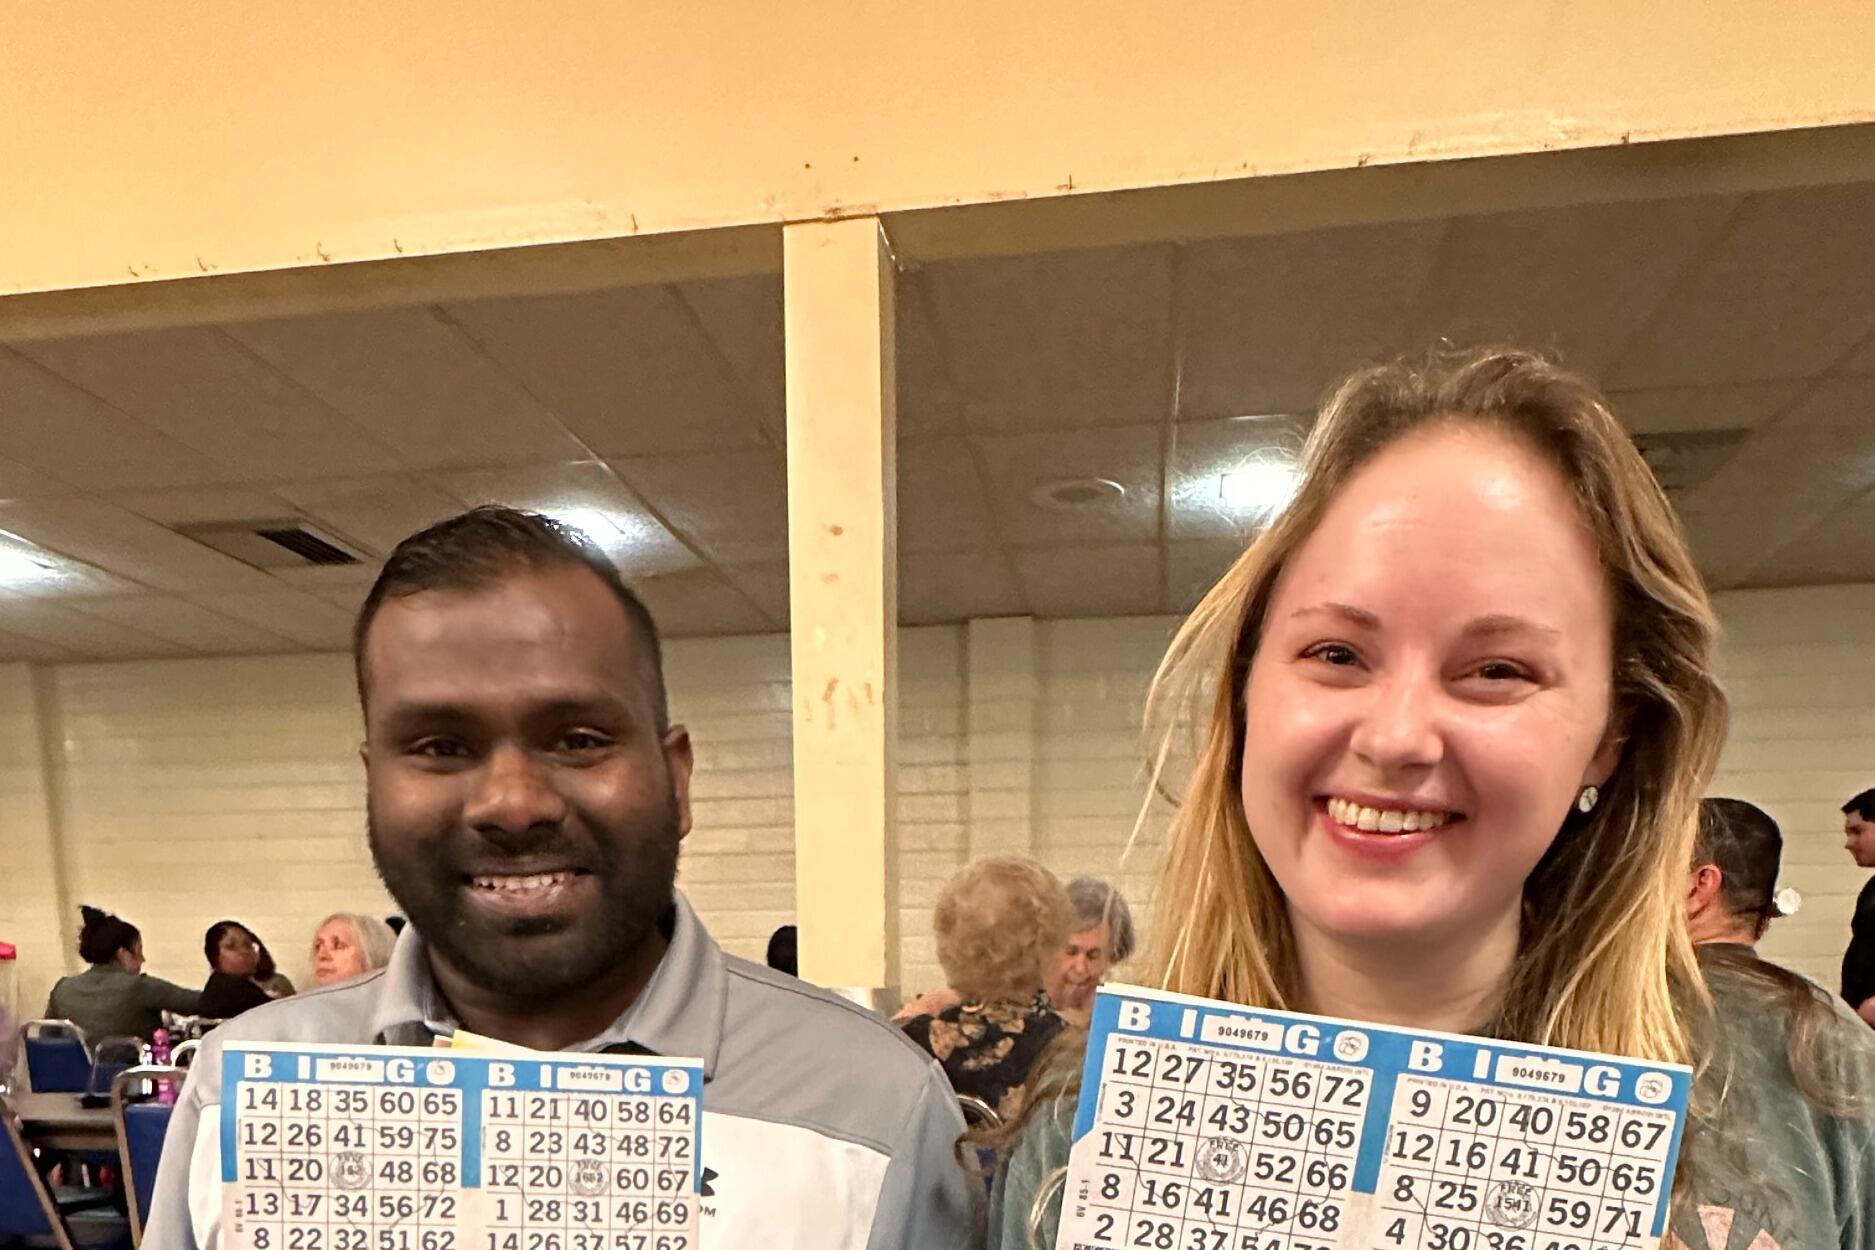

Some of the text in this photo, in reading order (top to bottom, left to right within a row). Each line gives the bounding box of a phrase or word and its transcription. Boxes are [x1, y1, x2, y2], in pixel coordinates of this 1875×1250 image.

[1218, 1026, 1268, 1042] 9049679
[1112, 1048, 1365, 1107] 12 27 35 56 72
[1512, 1067, 1565, 1083] 9049679
[245, 1087, 457, 1115] 14 18 35 60 65
[489, 1096, 691, 1124] 11 21 40 58 64
[1410, 1090, 1666, 1151] 9 20 40 58 67
